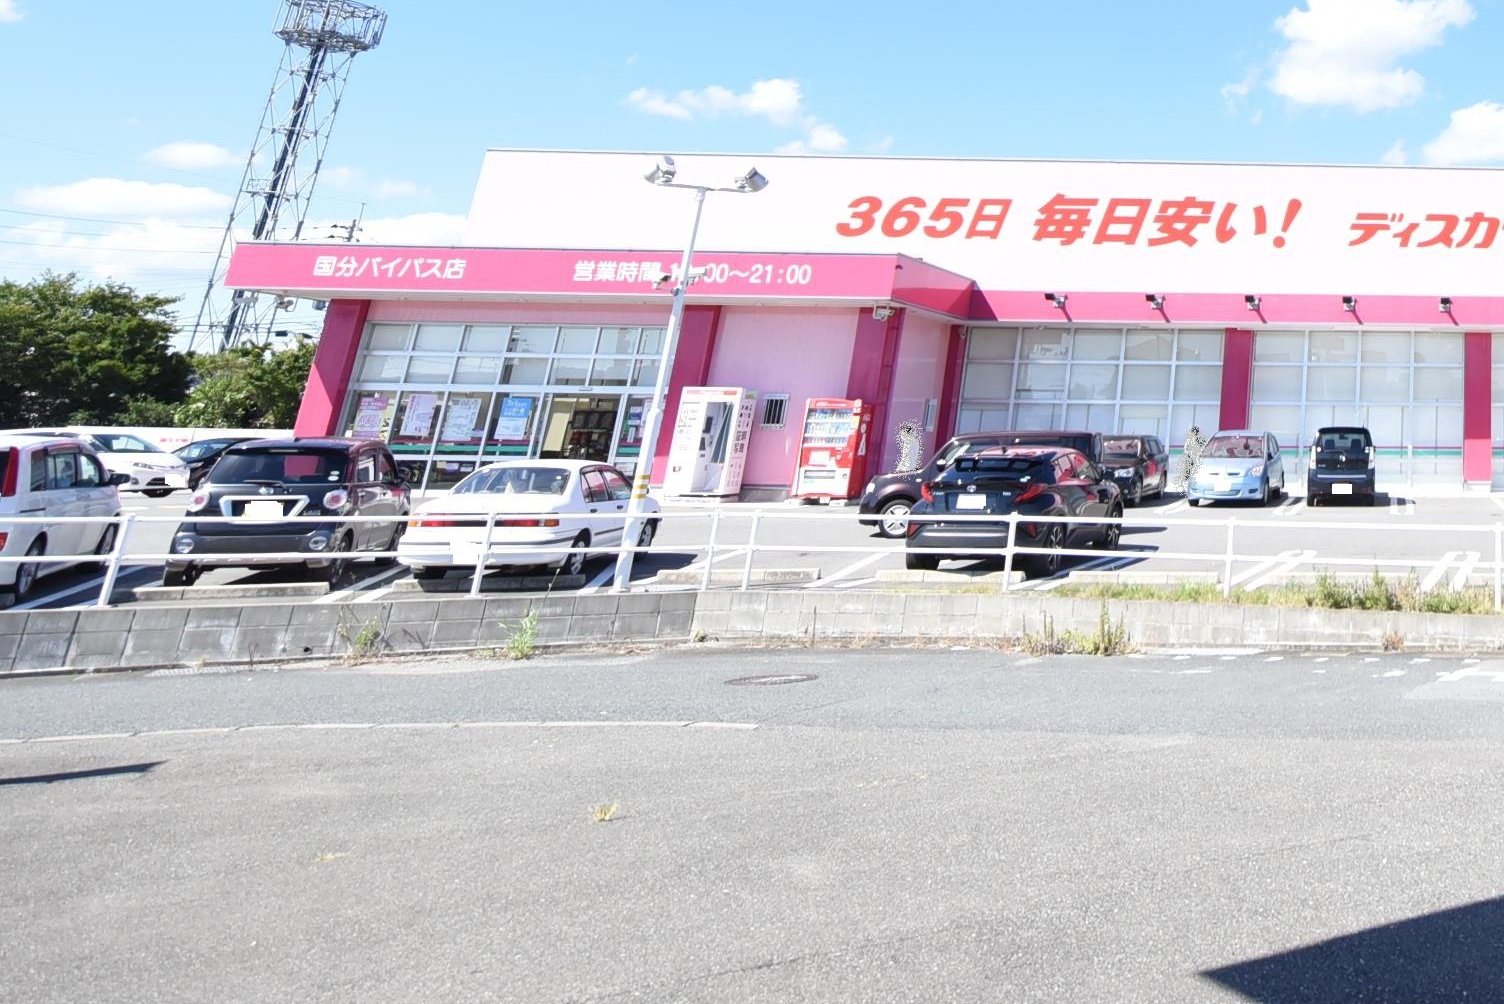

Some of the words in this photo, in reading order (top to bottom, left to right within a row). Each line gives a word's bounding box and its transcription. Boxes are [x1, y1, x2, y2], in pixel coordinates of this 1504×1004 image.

[836, 195, 1012, 239] 365日
[313, 255, 467, 279] 国分バイパス店
